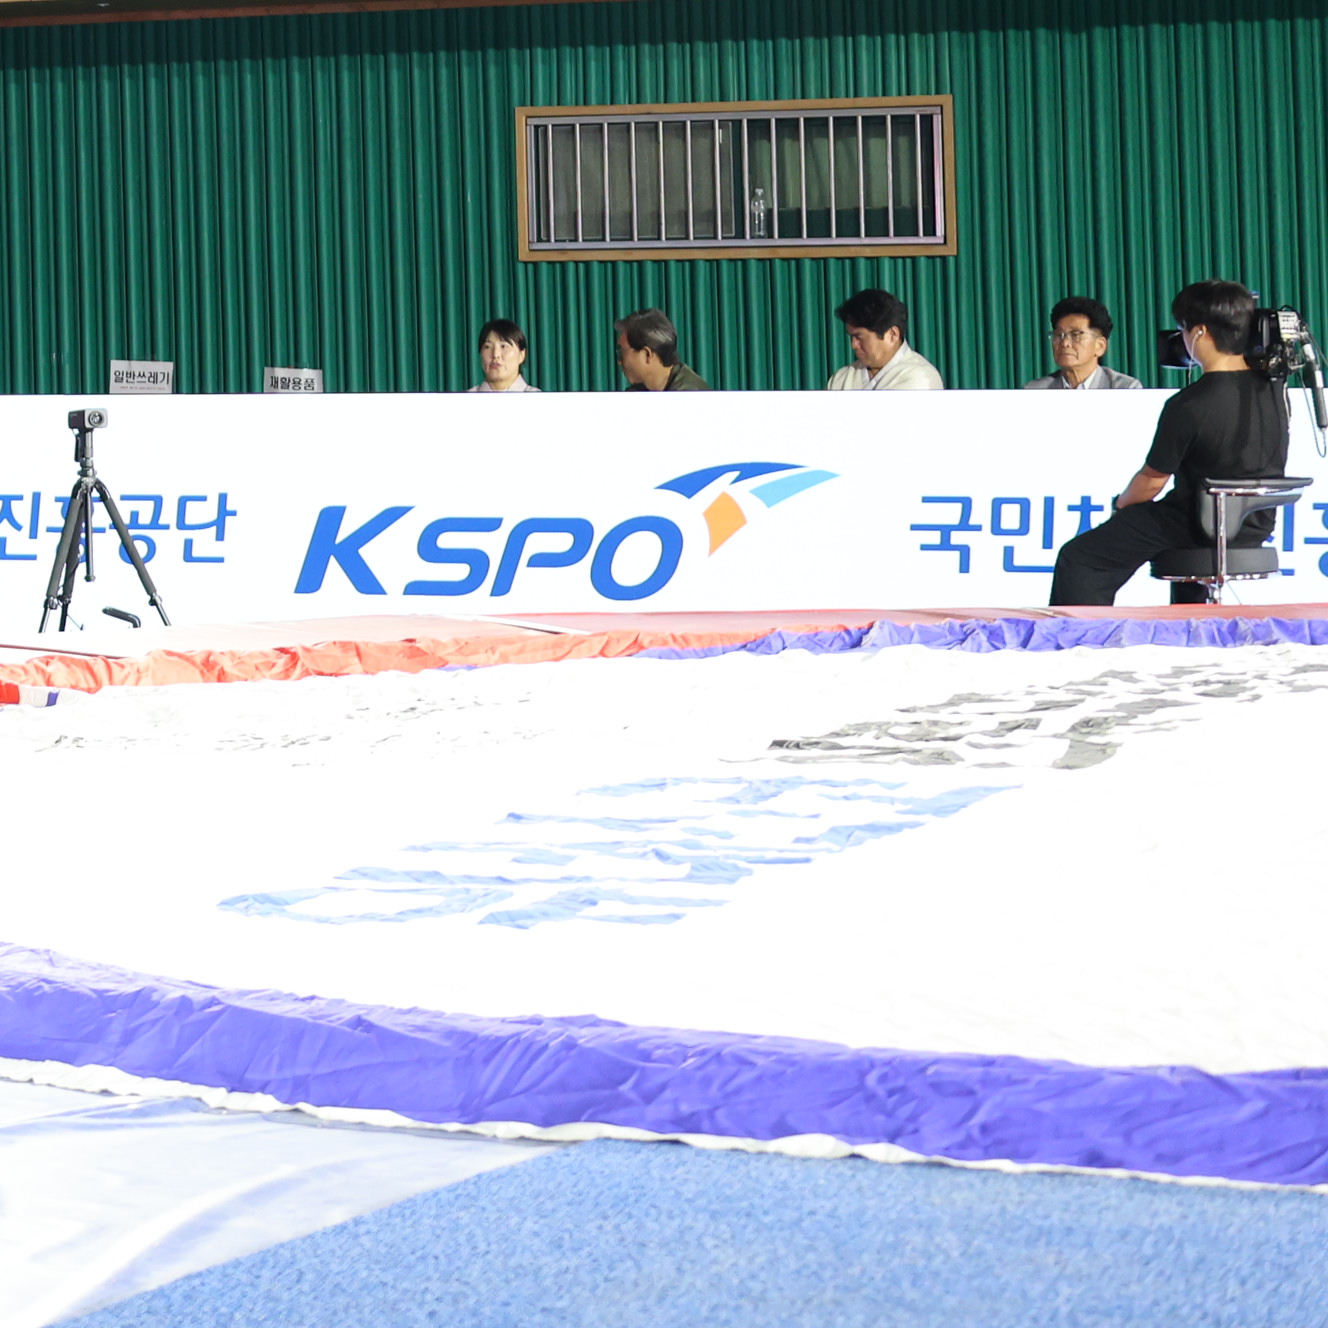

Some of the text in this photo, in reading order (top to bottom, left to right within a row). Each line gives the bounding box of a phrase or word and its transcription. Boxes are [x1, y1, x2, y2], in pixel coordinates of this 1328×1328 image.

[113, 370, 170, 385] 일반쓰레기
[269, 376, 315, 390] 재활용품
[293, 503, 684, 600] KSPO
